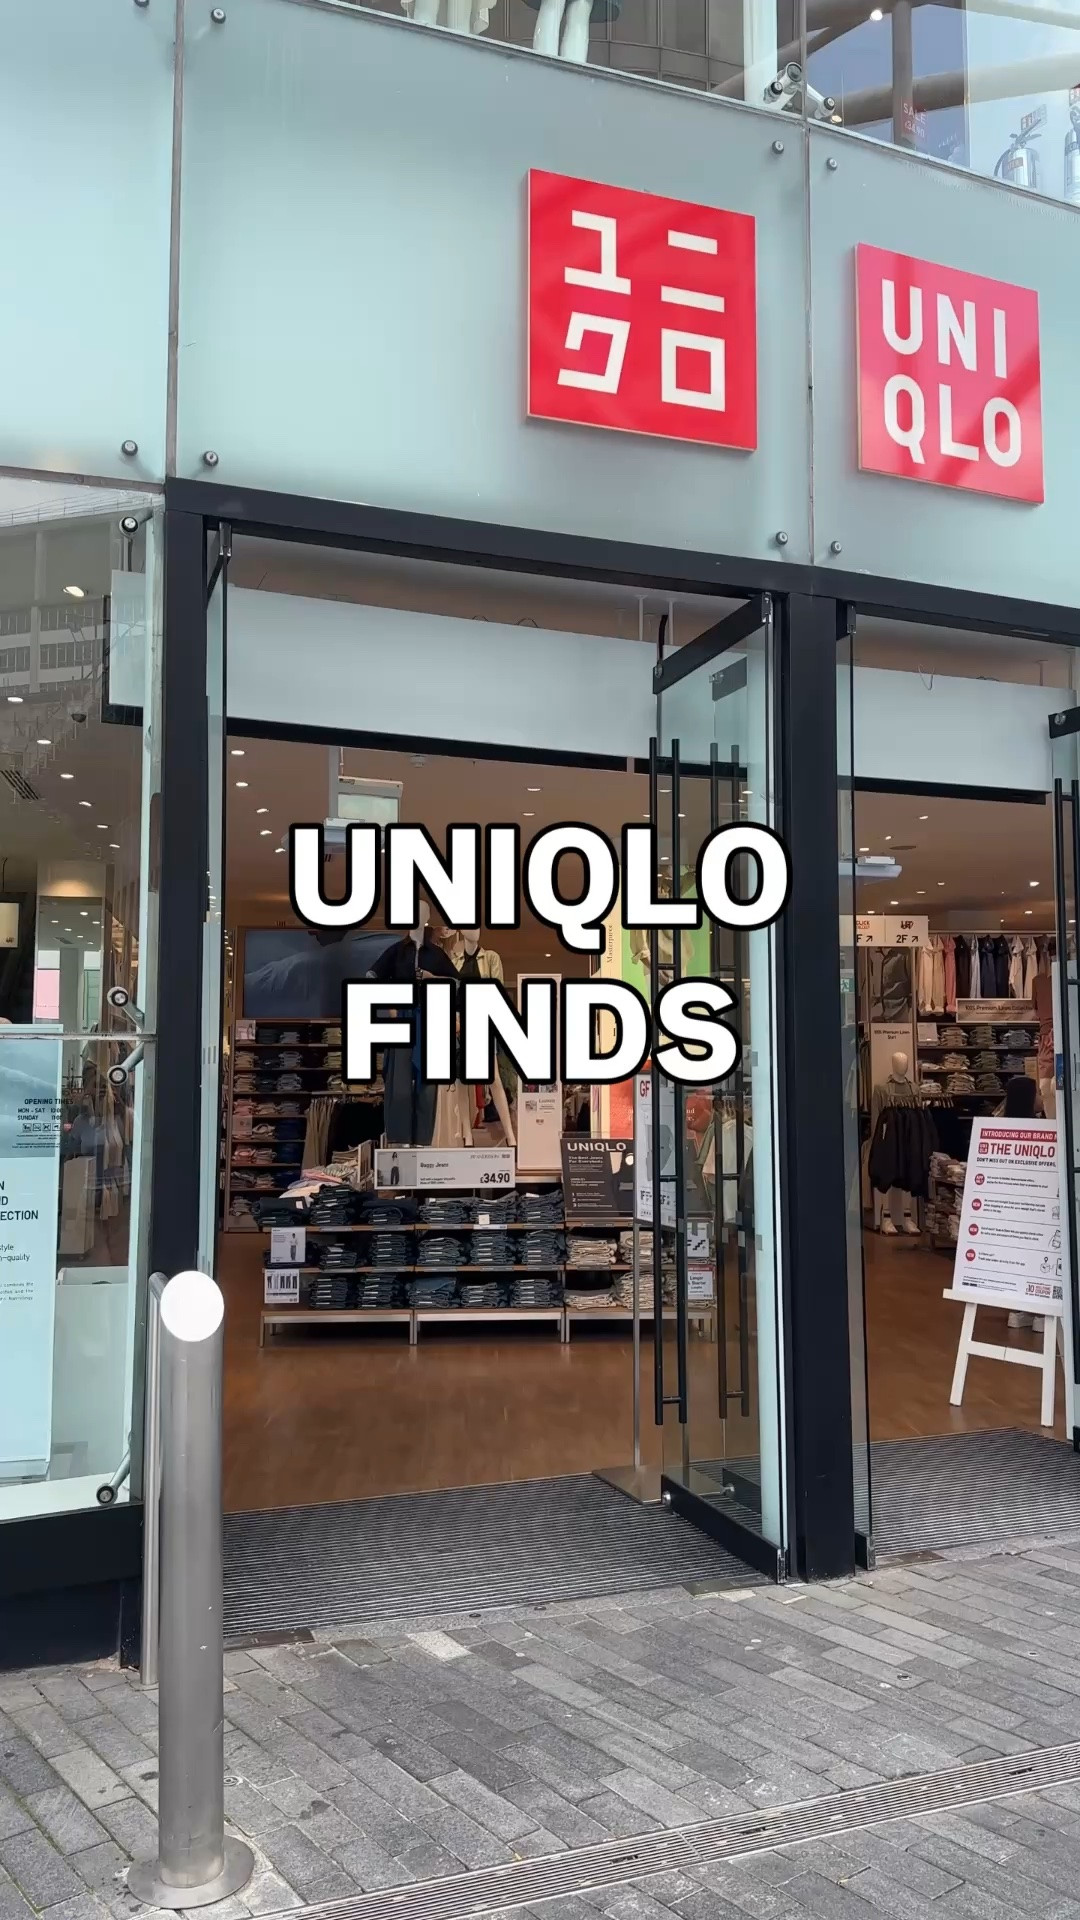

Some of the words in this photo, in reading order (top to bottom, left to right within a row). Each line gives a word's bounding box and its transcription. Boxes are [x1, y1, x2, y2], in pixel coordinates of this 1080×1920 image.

[903, 103, 926, 125] SALE
[564, 210, 725, 313] ユニ
[882, 279, 1007, 379] UNI
[557, 311, 725, 412] クロ
[883, 374, 1021, 468] QLO
[896, 934, 908, 944] 2F
[982, 1130, 1018, 1138] INTRODUCING
[567, 1142, 626, 1152] UNIQLO
[990, 1143, 1012, 1155] THE
[1014, 1144, 1056, 1158] UNIQLO
[480, 1172, 510, 1184] £34.90
[0, 1210, 38, 1220] ECTION
